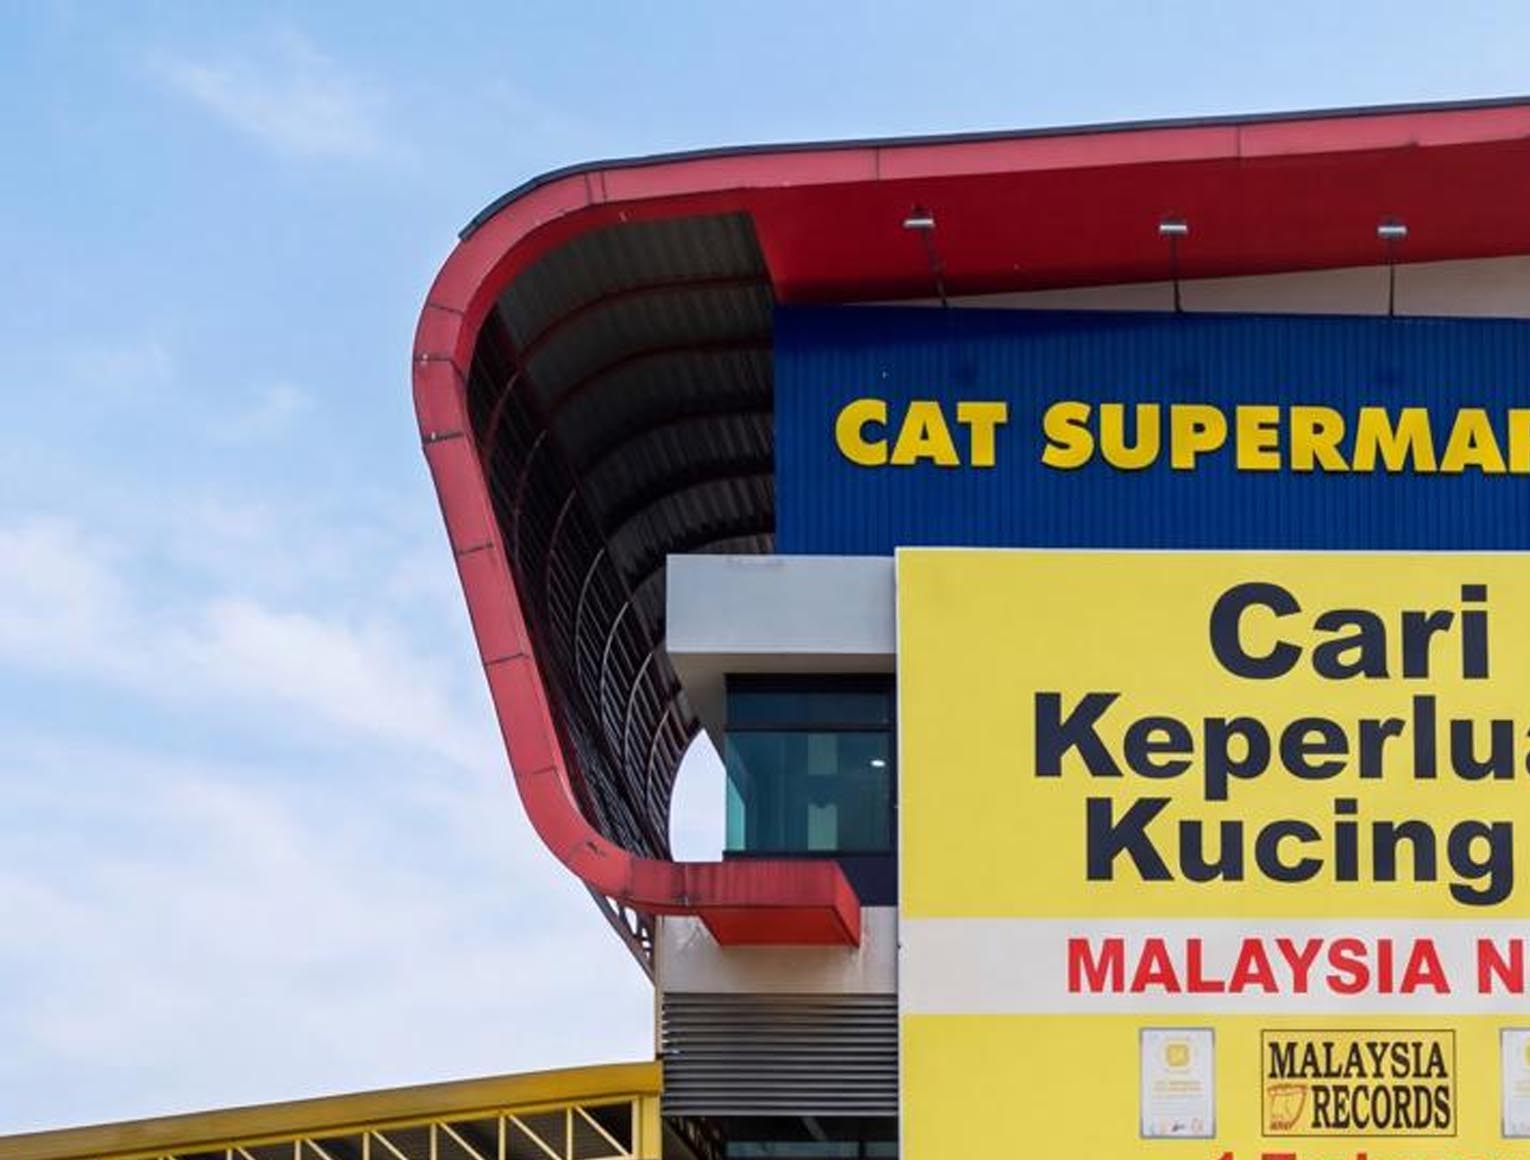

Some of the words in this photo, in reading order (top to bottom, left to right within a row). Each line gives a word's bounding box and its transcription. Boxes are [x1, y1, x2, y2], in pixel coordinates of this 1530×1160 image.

[835, 399, 1007, 466] CAT
[1209, 582, 1489, 680] Cari
[1085, 797, 1514, 906] Kucing
[1067, 937, 1450, 995] MALAYSIA
[1268, 1042, 1448, 1079] MALAYSIA
[1311, 1085, 1450, 1129] RECORDS
